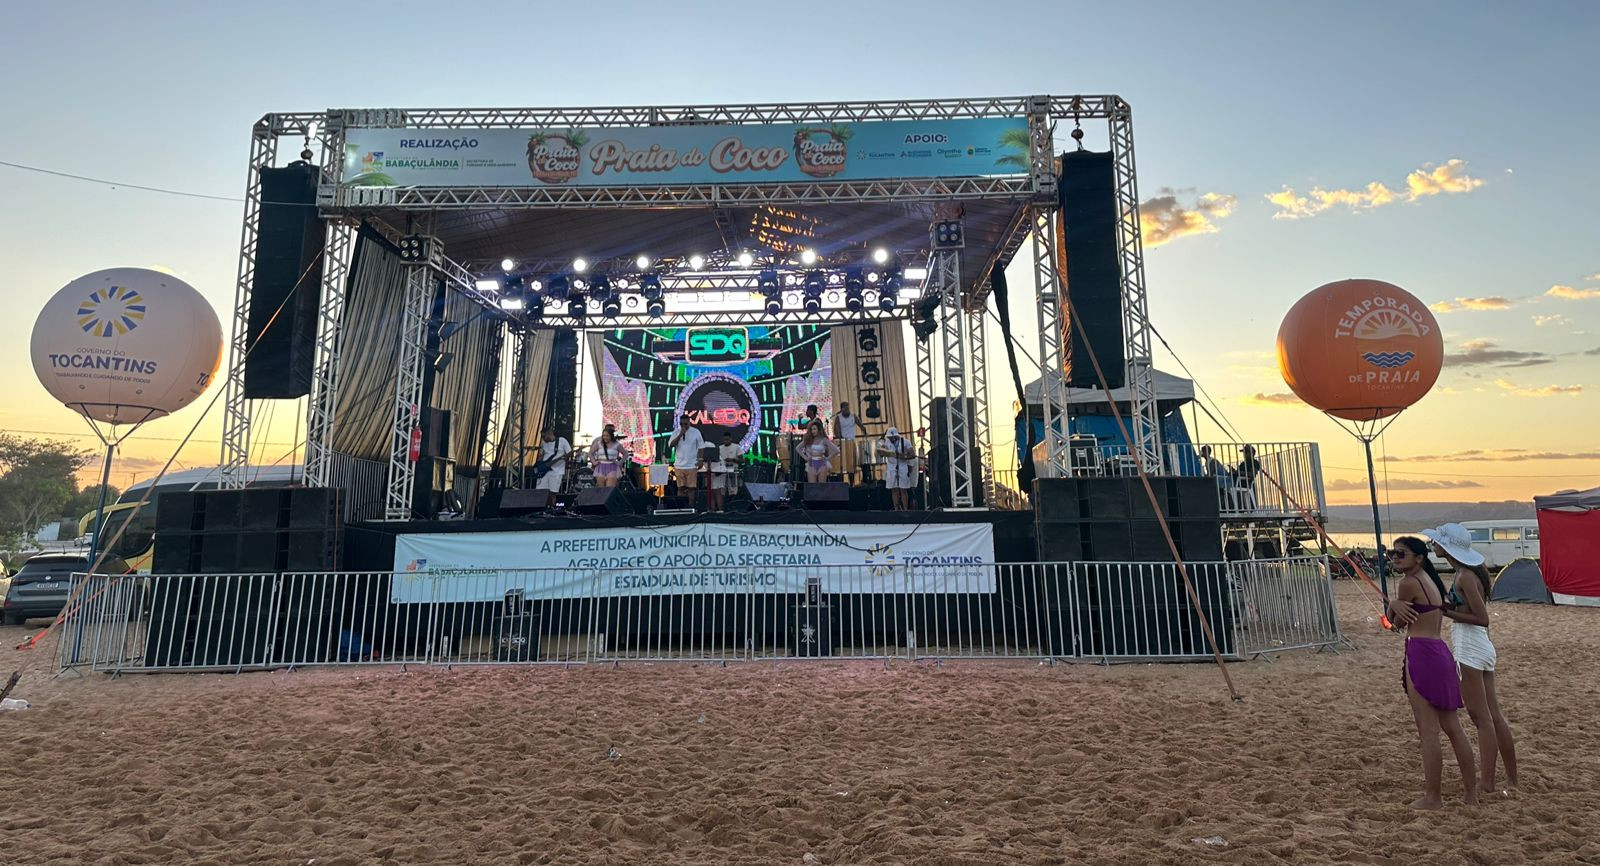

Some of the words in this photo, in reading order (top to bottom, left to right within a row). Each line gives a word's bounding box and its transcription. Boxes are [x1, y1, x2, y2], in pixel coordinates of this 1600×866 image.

[400, 137, 479, 150] REALIZAÇÃO
[904, 134, 947, 144] APOIO:
[800, 139, 844, 154] Praia
[590, 139, 678, 175] Praia
[680, 148, 706, 168] do
[709, 136, 789, 174] Coco
[811, 152, 845, 165] Coco
[386, 157, 459, 169] BABAÇULÂNDIA
[544, 158, 578, 171] Coco
[1335, 296, 1430, 339] TEMPORADA
[77, 348, 112, 356] GOVERNO
[690, 334, 747, 358] SDQ
[49, 354, 157, 374] TOCANTINS
[1349, 375, 1362, 383] DE
[1366, 370, 1420, 384] PRAIA
[541, 541, 551, 552] A
[554, 537, 636, 552] PREFEITURA
[639, 535, 716, 549] MUNICIPAL
[718, 535, 737, 547] DE
[740, 532, 848, 550] BABAÇULÂNDIA
[565, 556, 645, 572] AGRADECE
[648, 555, 661, 567] O
[664, 554, 712, 568] APOIO
[716, 554, 735, 566] DA
[738, 553, 821, 566] SECRETARIA
[902, 556, 982, 568] TOCANTINS
[615, 574, 687, 589] ESTADUAL
[689, 573, 708, 586] DE
[711, 573, 776, 586] TURISMO
